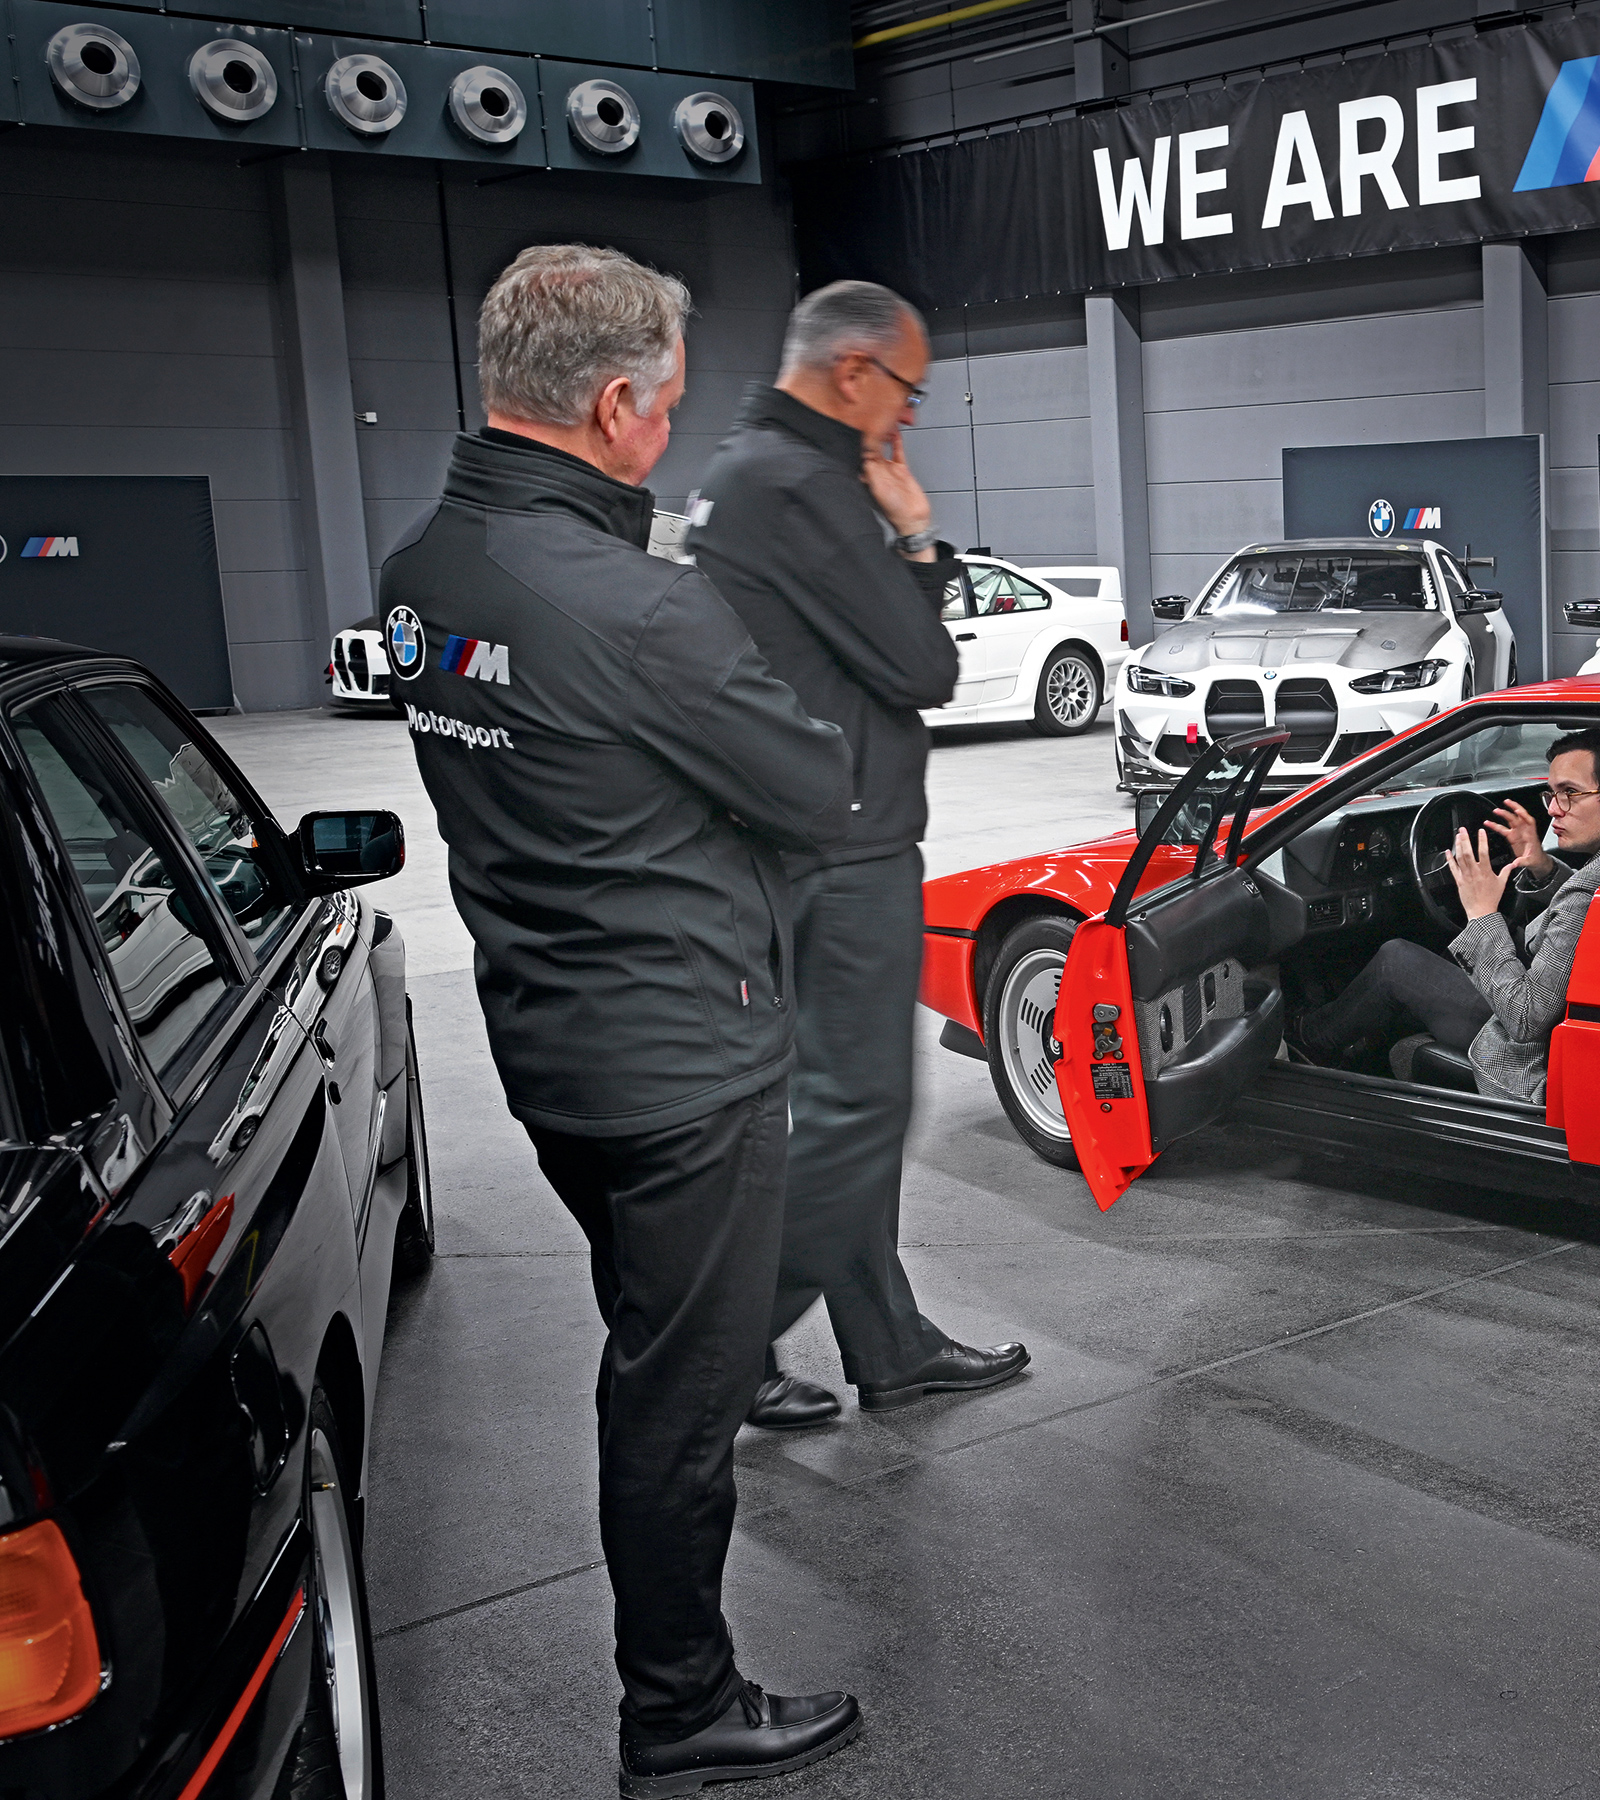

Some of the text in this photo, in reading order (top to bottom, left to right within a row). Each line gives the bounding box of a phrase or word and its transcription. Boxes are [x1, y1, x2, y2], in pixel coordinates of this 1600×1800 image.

[1093, 125, 1234, 251] WE
[1261, 77, 1482, 229] ARE
[1418, 507, 1441, 529] M
[45, 536, 79, 557] M
[463, 640, 511, 686] M
[404, 702, 514, 749] Motorsport
